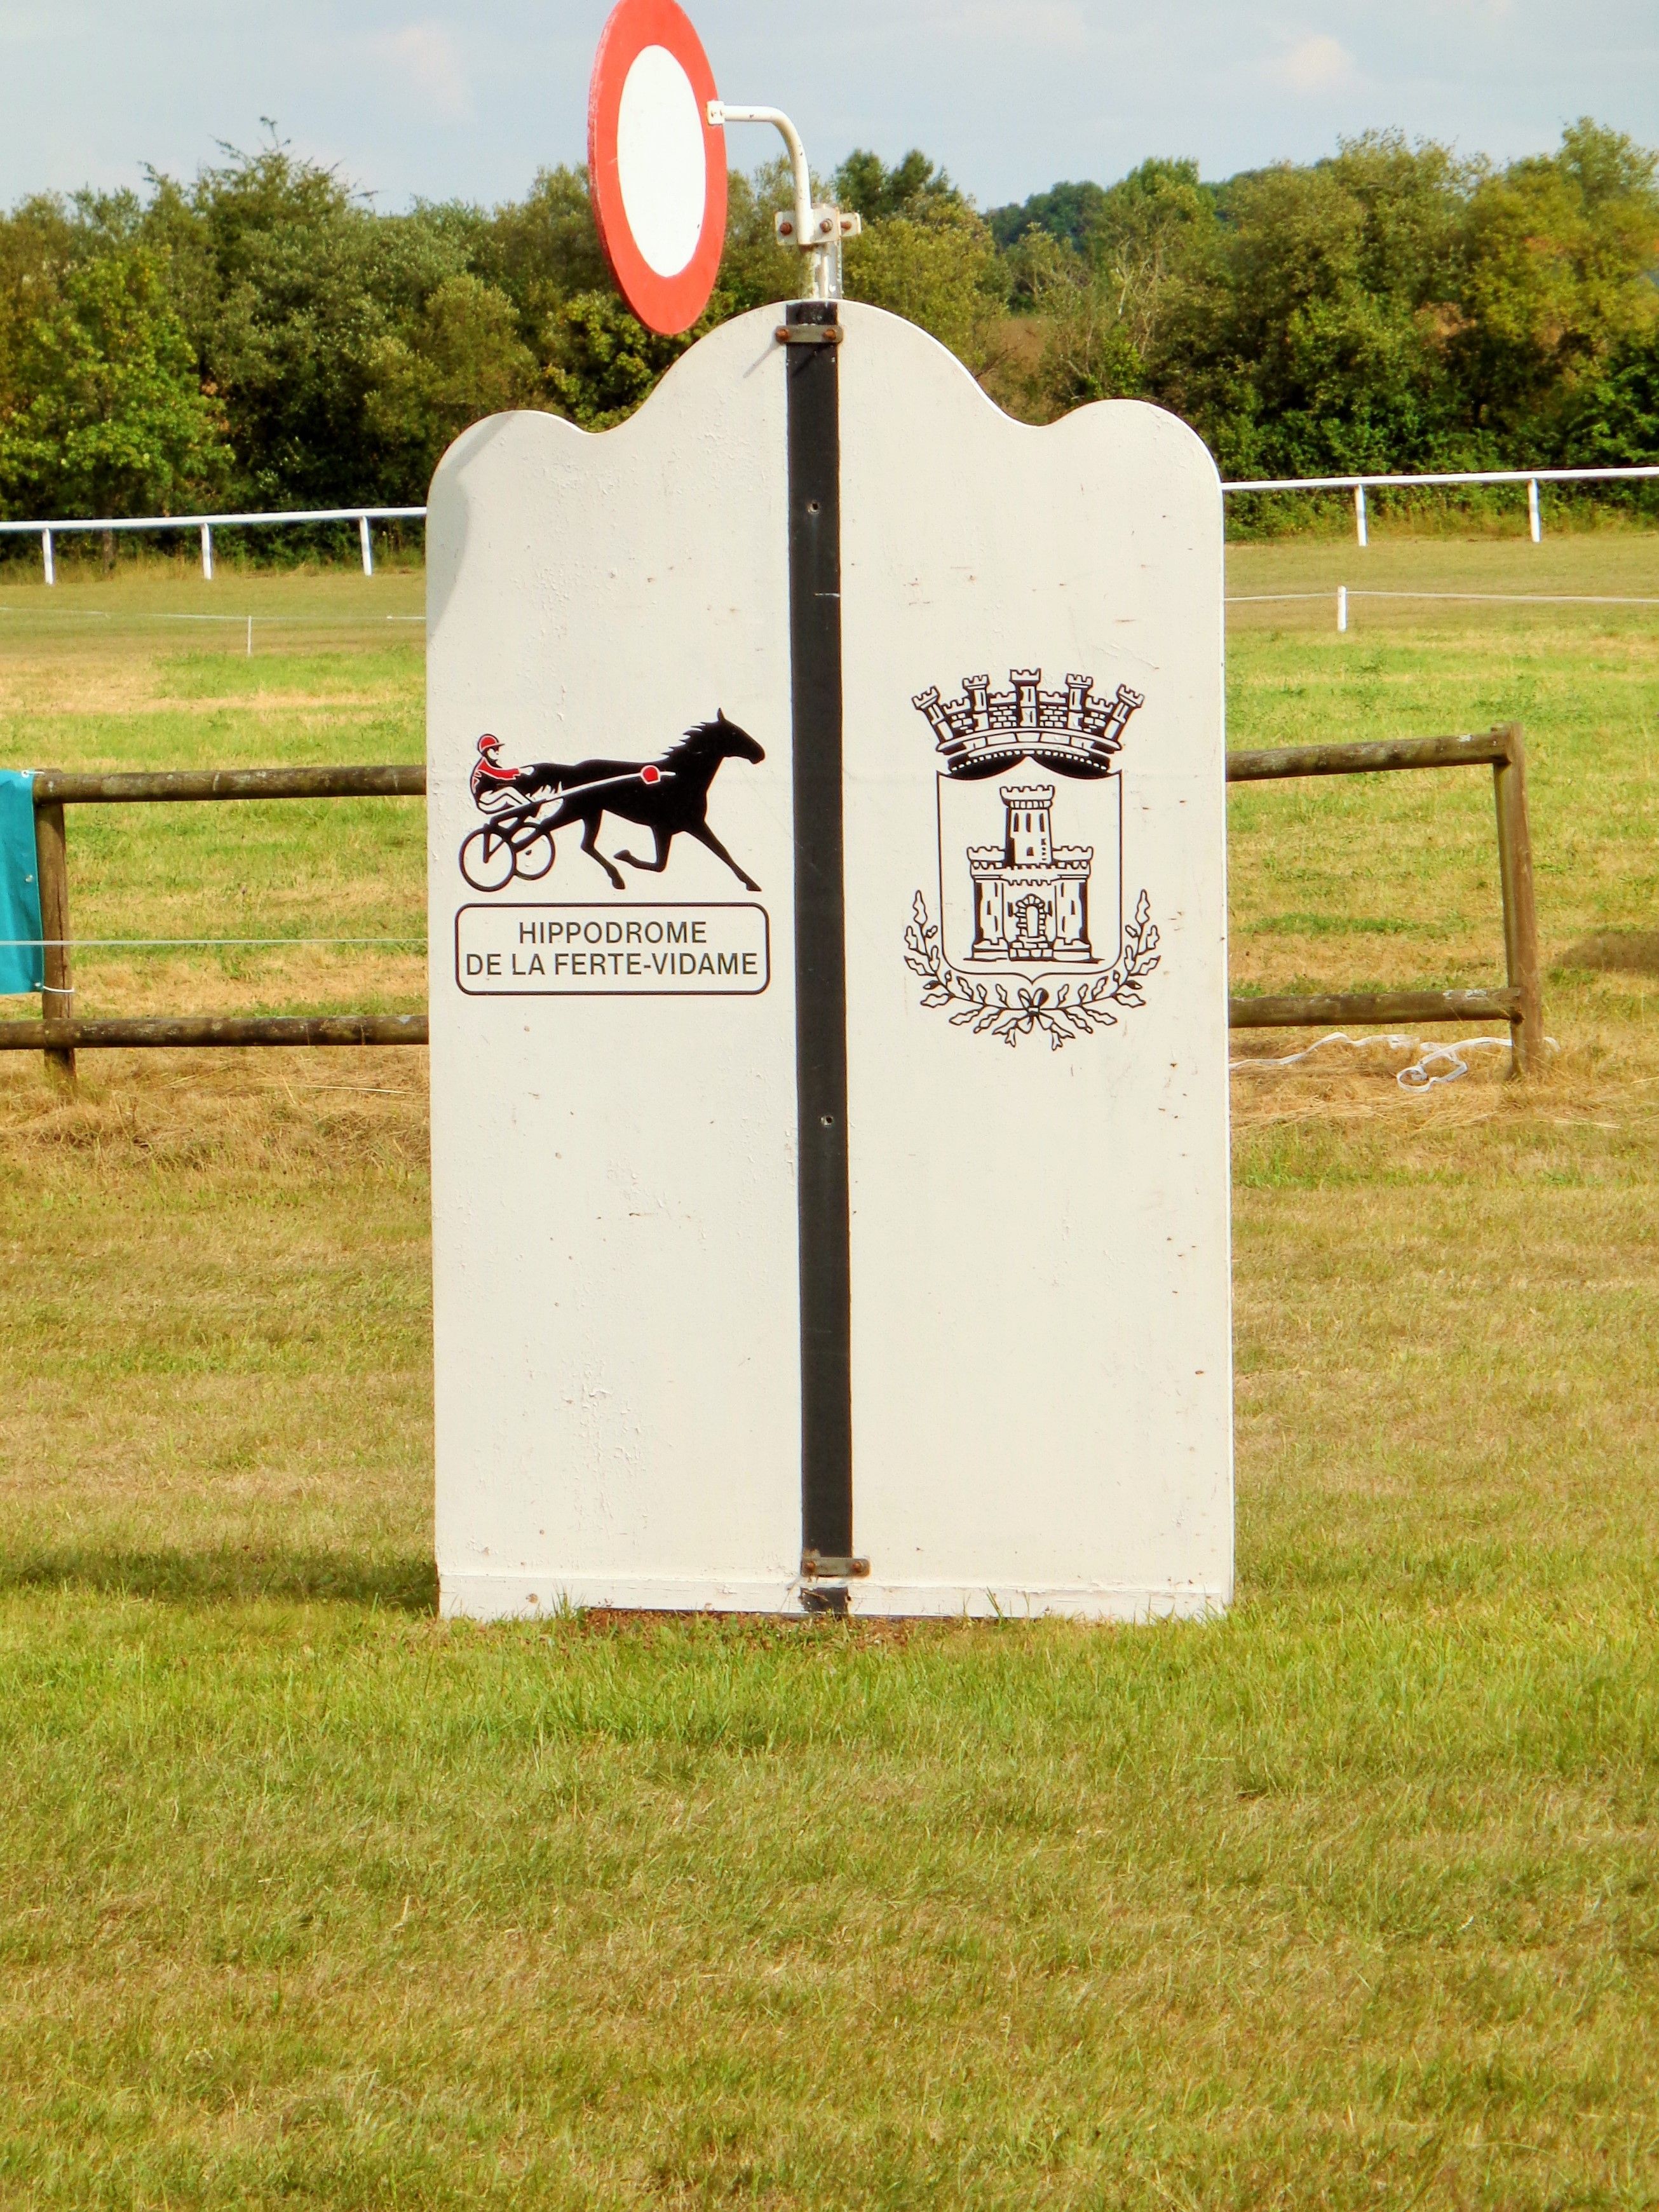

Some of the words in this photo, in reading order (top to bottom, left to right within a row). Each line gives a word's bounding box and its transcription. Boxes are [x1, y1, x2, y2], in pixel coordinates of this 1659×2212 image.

[518, 921, 707, 944] HIPPODROME
[466, 953, 503, 975] DE
[511, 953, 546, 975] LA
[554, 952, 759, 975] FERTE-VIDAME
